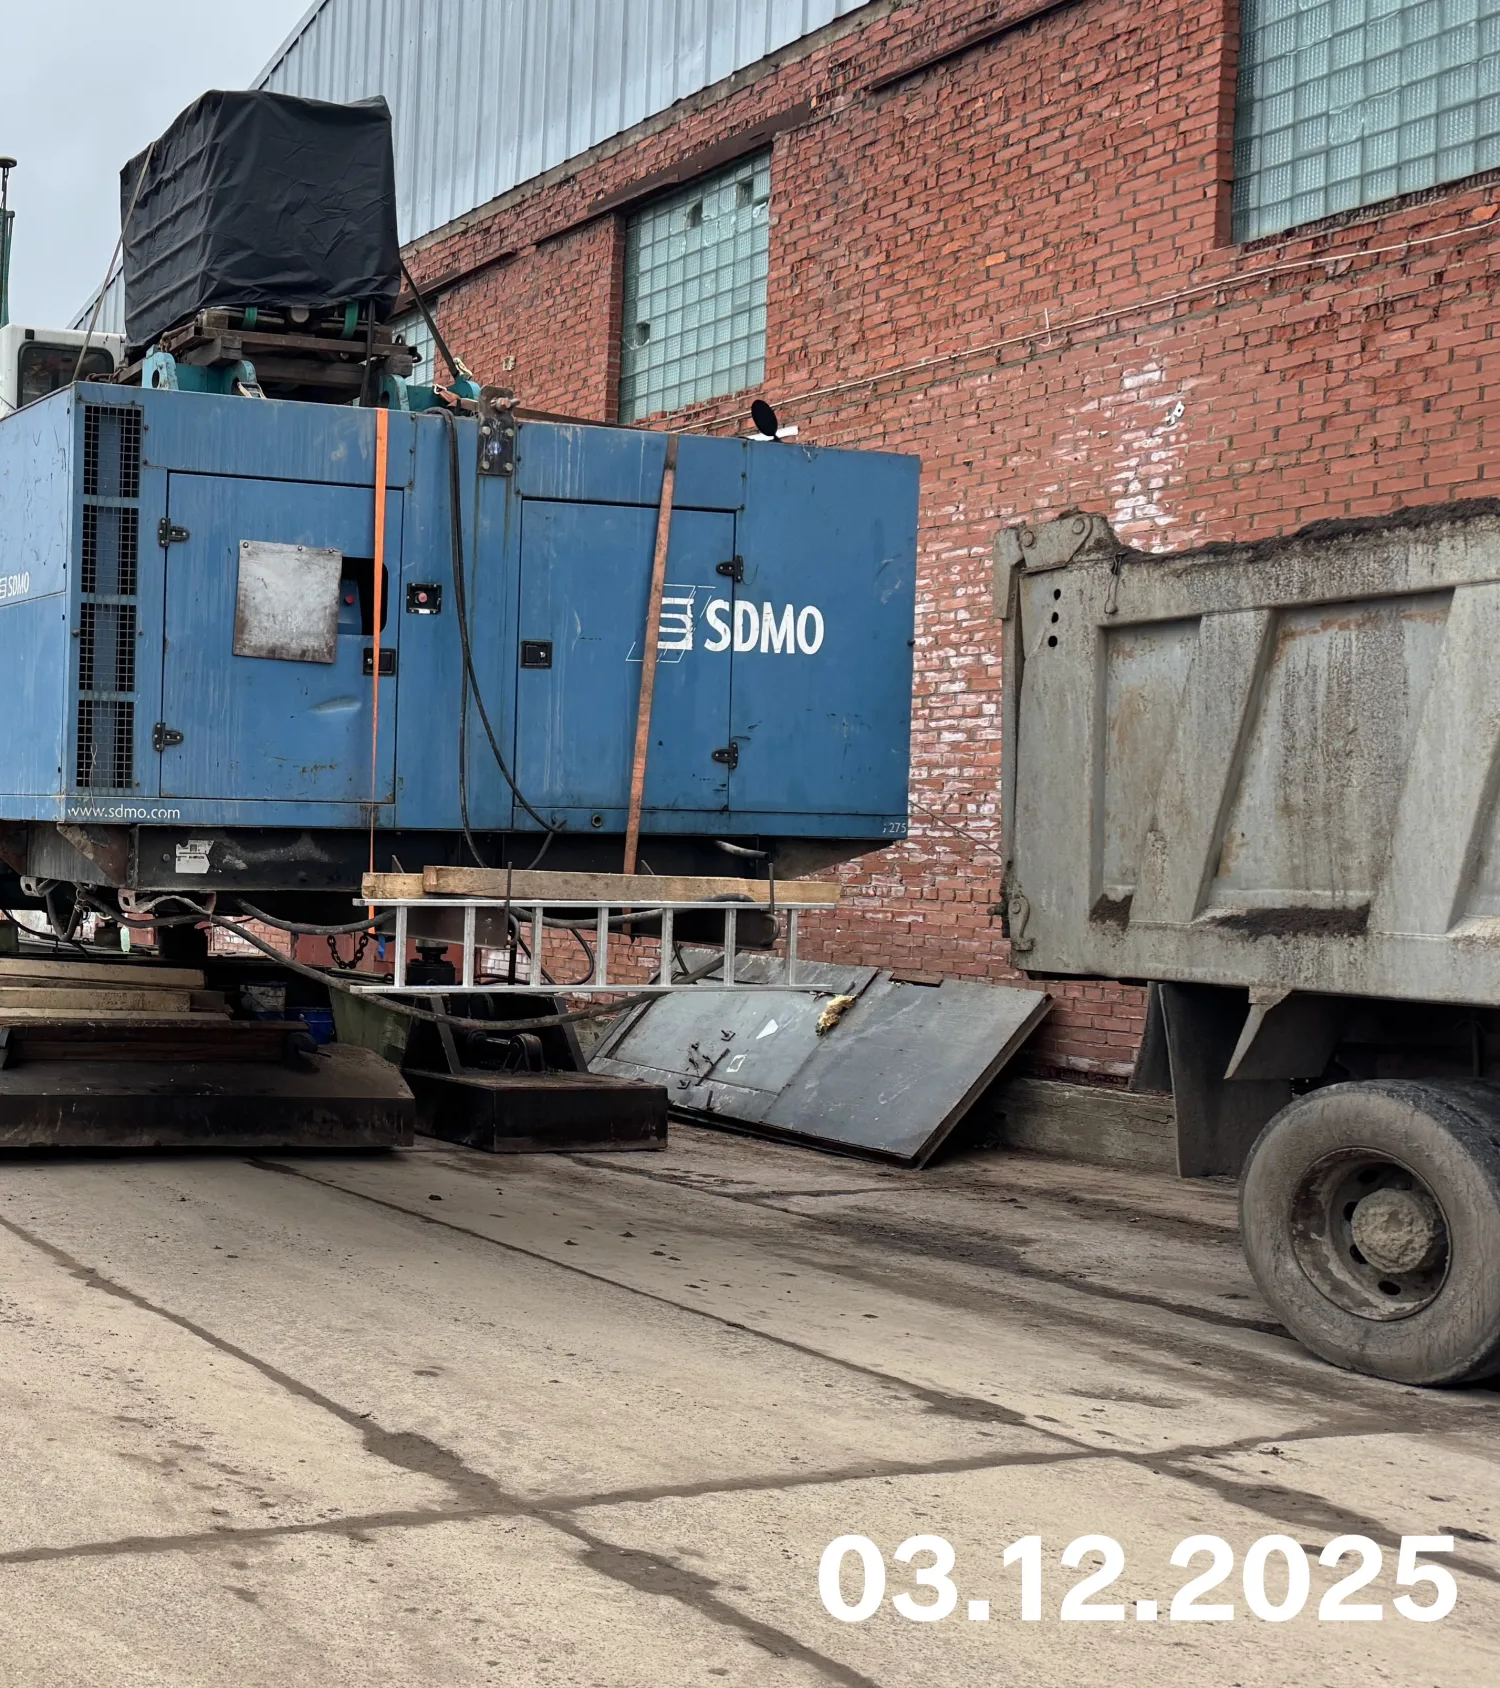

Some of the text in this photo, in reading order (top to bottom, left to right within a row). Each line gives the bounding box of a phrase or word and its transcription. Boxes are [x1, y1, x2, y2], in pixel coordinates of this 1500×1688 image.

[7, 571, 30, 597] SDMO
[703, 598, 825, 655] SDMO
[67, 804, 181, 820] www.sdmo.com
[889, 822, 907, 833] 275
